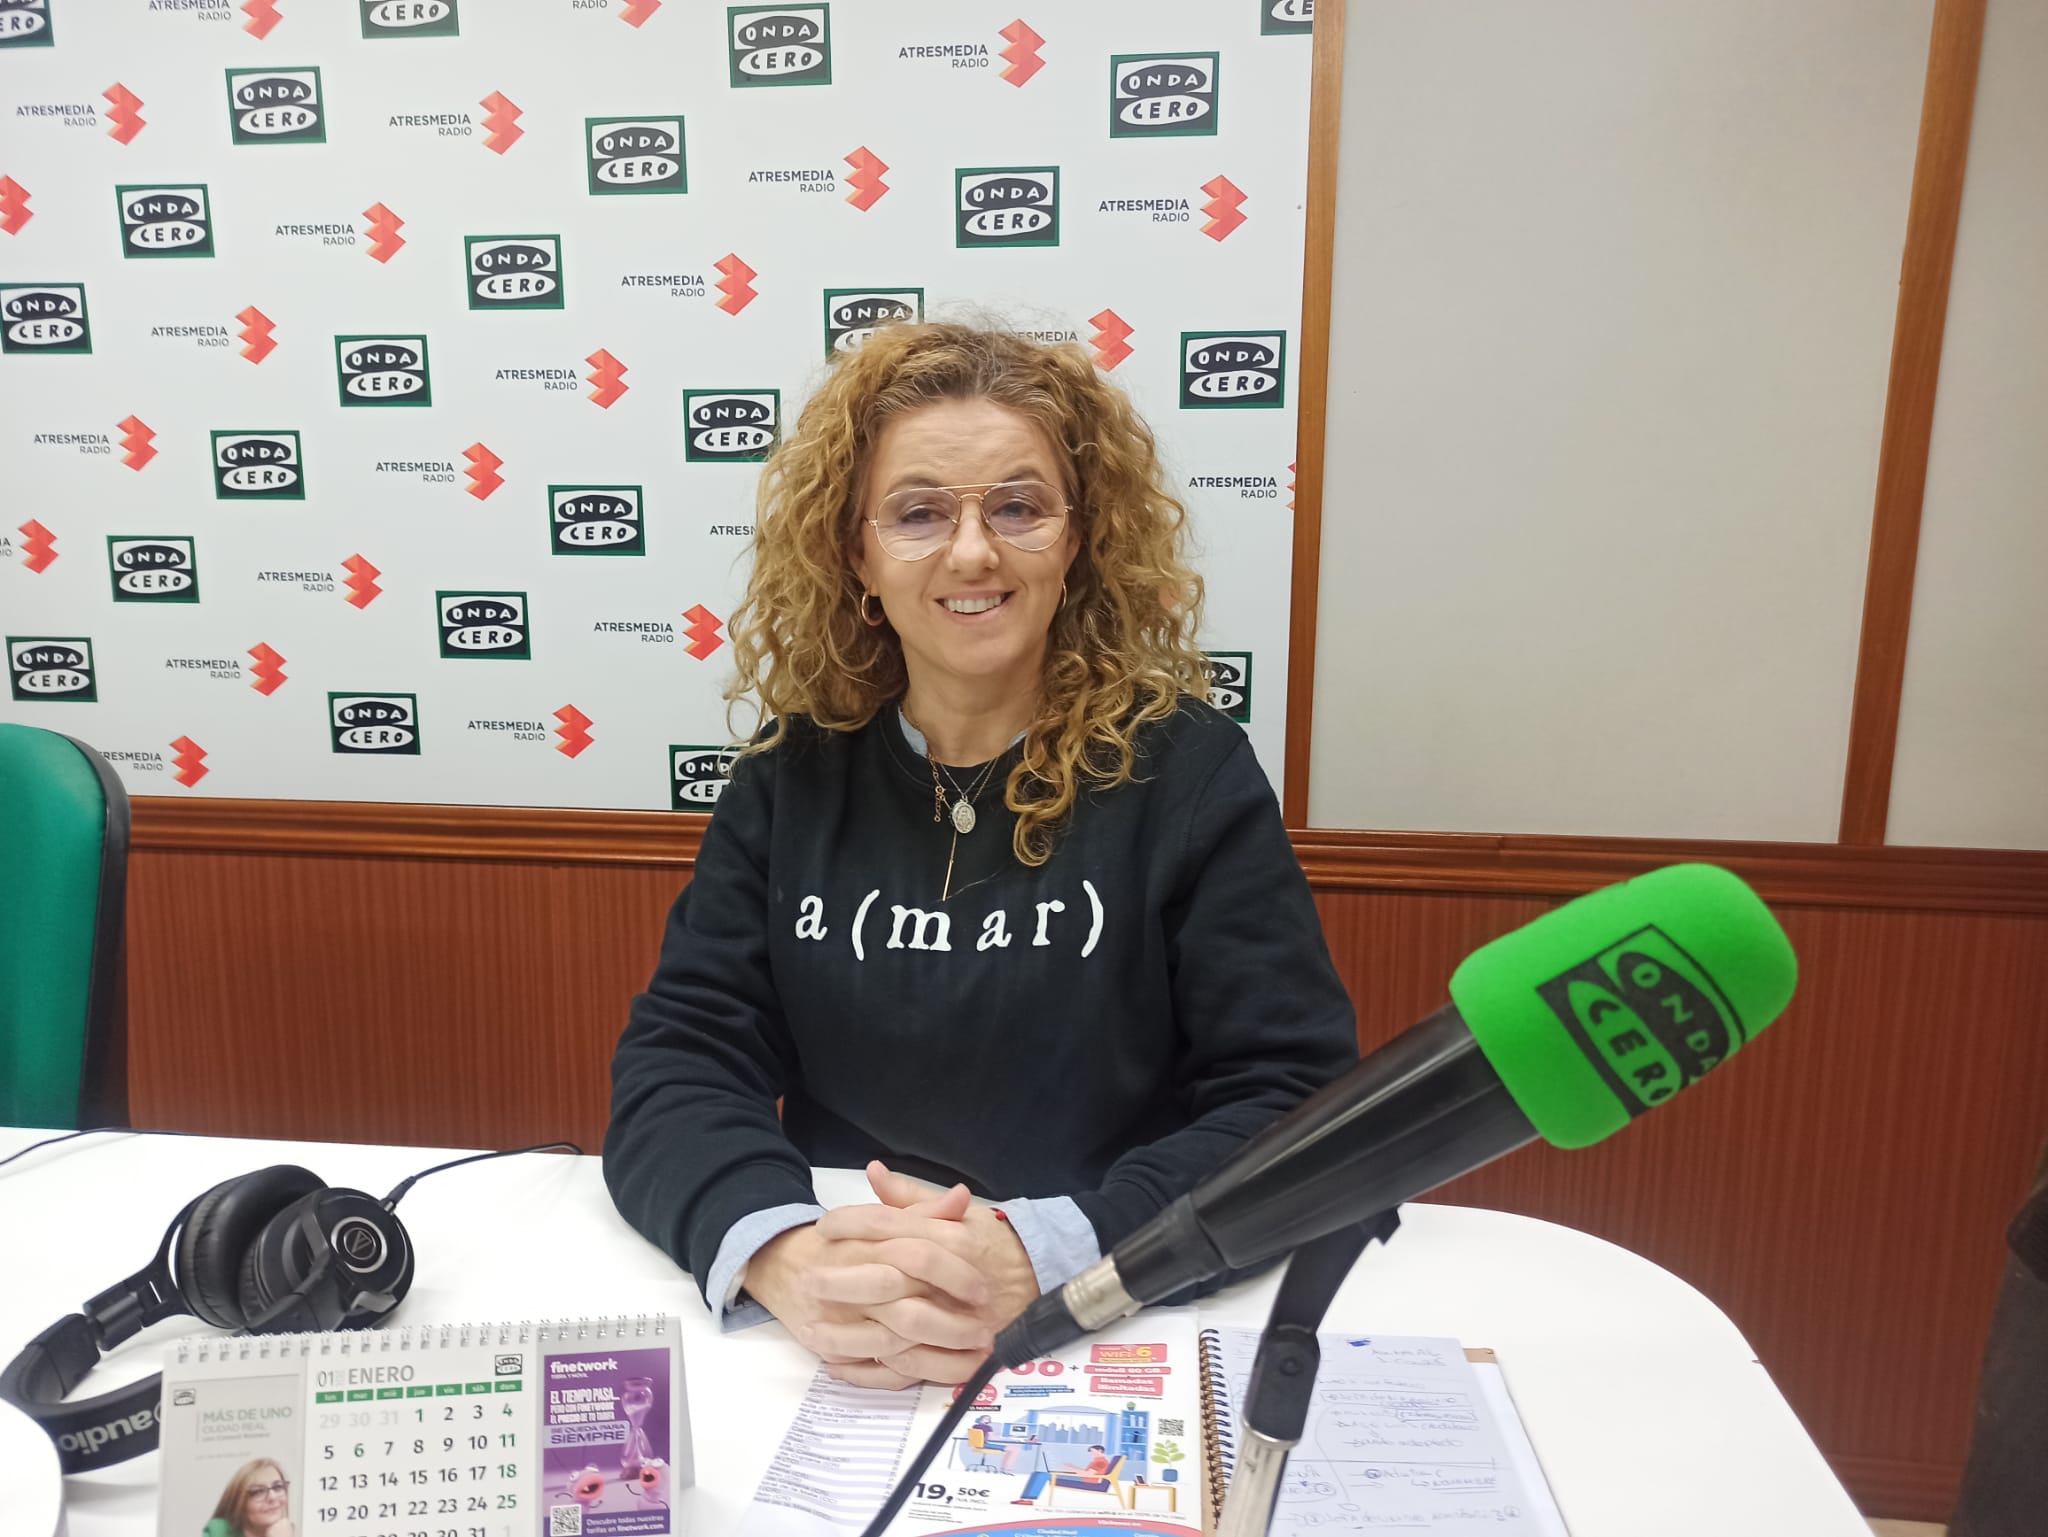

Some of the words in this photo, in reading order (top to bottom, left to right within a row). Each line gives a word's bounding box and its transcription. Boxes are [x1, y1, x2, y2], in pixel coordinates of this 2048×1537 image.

[380, 3, 439, 21] CERO
[1284, 0, 1313, 15] CE
[198, 11, 232, 21] RADIO
[0, 16, 34, 31] ERO
[745, 24, 811, 40] ONDA
[899, 44, 988, 58] ATRESMEDIA
[750, 51, 812, 69] CERO
[952, 58, 989, 69] RADIO
[1129, 74, 1198, 90] ONDA
[243, 85, 305, 101] ONDA
[16, 105, 95, 116] ATRESMEDIA
[1132, 101, 1198, 119] CERO
[64, 117, 97, 127] RADIO
[250, 112, 308, 128] CERO
[389, 114, 471, 127] ATRESMEDIA
[438, 127, 472, 137] RADIO
[603, 135, 667, 150] ONDA
[608, 162, 668, 178] CERO
[749, 170, 834, 182] ATRESMEDIA
[800, 183, 835, 193] RADIO
[973, 186, 1040, 202] ONDA
[133, 201, 193, 216] ONDA
[1099, 199, 1190, 212] ATRESMEDIA
[977, 213, 1040, 231] CERO
[1152, 212, 1190, 222] RADIO
[140, 227, 195, 242] CERO
[275, 224, 355, 236] ATRESMEDIA
[323, 236, 356, 246] RADIO
[481, 252, 544, 268] ONDA
[487, 278, 546, 294] CERO
[621, 275, 705, 287] ATRESMEDIA
[671, 287, 706, 298] RADIO
[12, 300, 71, 314] ONDA
[841, 306, 906, 322] ONDA
[18, 324, 74, 339] CERO
[151, 326, 228, 337] ATRESMEDIA
[197, 338, 230, 347] RADIO
[351, 352, 412, 366] ONDA
[1198, 350, 1265, 364] ONDA
[496, 369, 577, 381] ATRESMEDIA
[357, 376, 413, 392] CERO
[544, 381, 578, 391] RADIO
[1201, 376, 1265, 392] CERO
[700, 406, 763, 421] ONDA
[33, 434, 110, 444] ATRESMEDIA
[704, 431, 764, 446] CERO
[79, 445, 111, 455] RADIO
[227, 446, 286, 460] ONDA
[376, 462, 454, 473] ATRESMEDIA
[233, 471, 287, 485] CERO
[422, 473, 455, 483] RADIO
[1188, 477, 1277, 488] ATRESMEDIA
[1241, 489, 1277, 499] RADIO
[564, 502, 626, 516] ONDA
[570, 526, 627, 541] CERO
[123, 551, 180, 565] ONDA
[129, 574, 182, 588] CERO
[257, 571, 334, 582] ATRESMEDIA
[303, 583, 335, 593] RADIO
[452, 607, 512, 621] ONDA
[594, 622, 674, 633] ATRESMEDIA
[458, 630, 513, 644] CERO
[641, 634, 674, 643] RADIO
[22, 652, 79, 665] ONDA
[165, 658, 240, 670] ATRESMEDIA
[28, 675, 80, 688] CERO
[210, 671, 241, 680] RADIO
[344, 709, 402, 720] ONDA
[467, 721, 545, 732] ATRESMEDIA
[350, 731, 403, 743] CERO
[514, 732, 546, 741] RADIO
[133, 762, 164, 771] RADIO
[685, 761, 730, 775] OND
[1589, 999, 1673, 1100] CERO
[550, 1358, 618, 1374] finetwork
[317, 1371, 334, 1387] 01
[348, 1365, 415, 1385] ENERO
[238, 1408, 258, 1421] DE
[261, 1406, 293, 1420] UNO
[319, 1413, 340, 1429] 29
[349, 1411, 370, 1428] 30
[379, 1410, 399, 1426] 31
[415, 1408, 423, 1422] 1
[444, 1406, 454, 1421] 2
[473, 1405, 483, 1419] 3
[503, 1403, 513, 1417] 4
[59, 1409, 154, 1454] audio
[551, 1430, 625, 1444] SIEMPRE
[324, 1445, 334, 1460] 5
[354, 1443, 365, 1458] 6
[384, 1441, 394, 1456] 7
[413, 1439, 424, 1454] 8
[443, 1437, 454, 1451] 9
[468, 1435, 488, 1450] 10
[499, 1433, 515, 1448] 11
[320, 1476, 338, 1491] 12
[350, 1474, 368, 1489] 13
[379, 1472, 398, 1487] 14
[409, 1470, 428, 1485] 15
[438, 1468, 458, 1482] 16
[469, 1466, 487, 1481] 17
[498, 1464, 517, 1478] 18
[318, 1507, 337, 1522] 19
[347, 1505, 368, 1520] 20
[379, 1503, 397, 1518] 21
[408, 1501, 428, 1516] 22
[437, 1499, 457, 1513] 23
[467, 1497, 488, 1511] 24
[496, 1494, 517, 1509] 25
